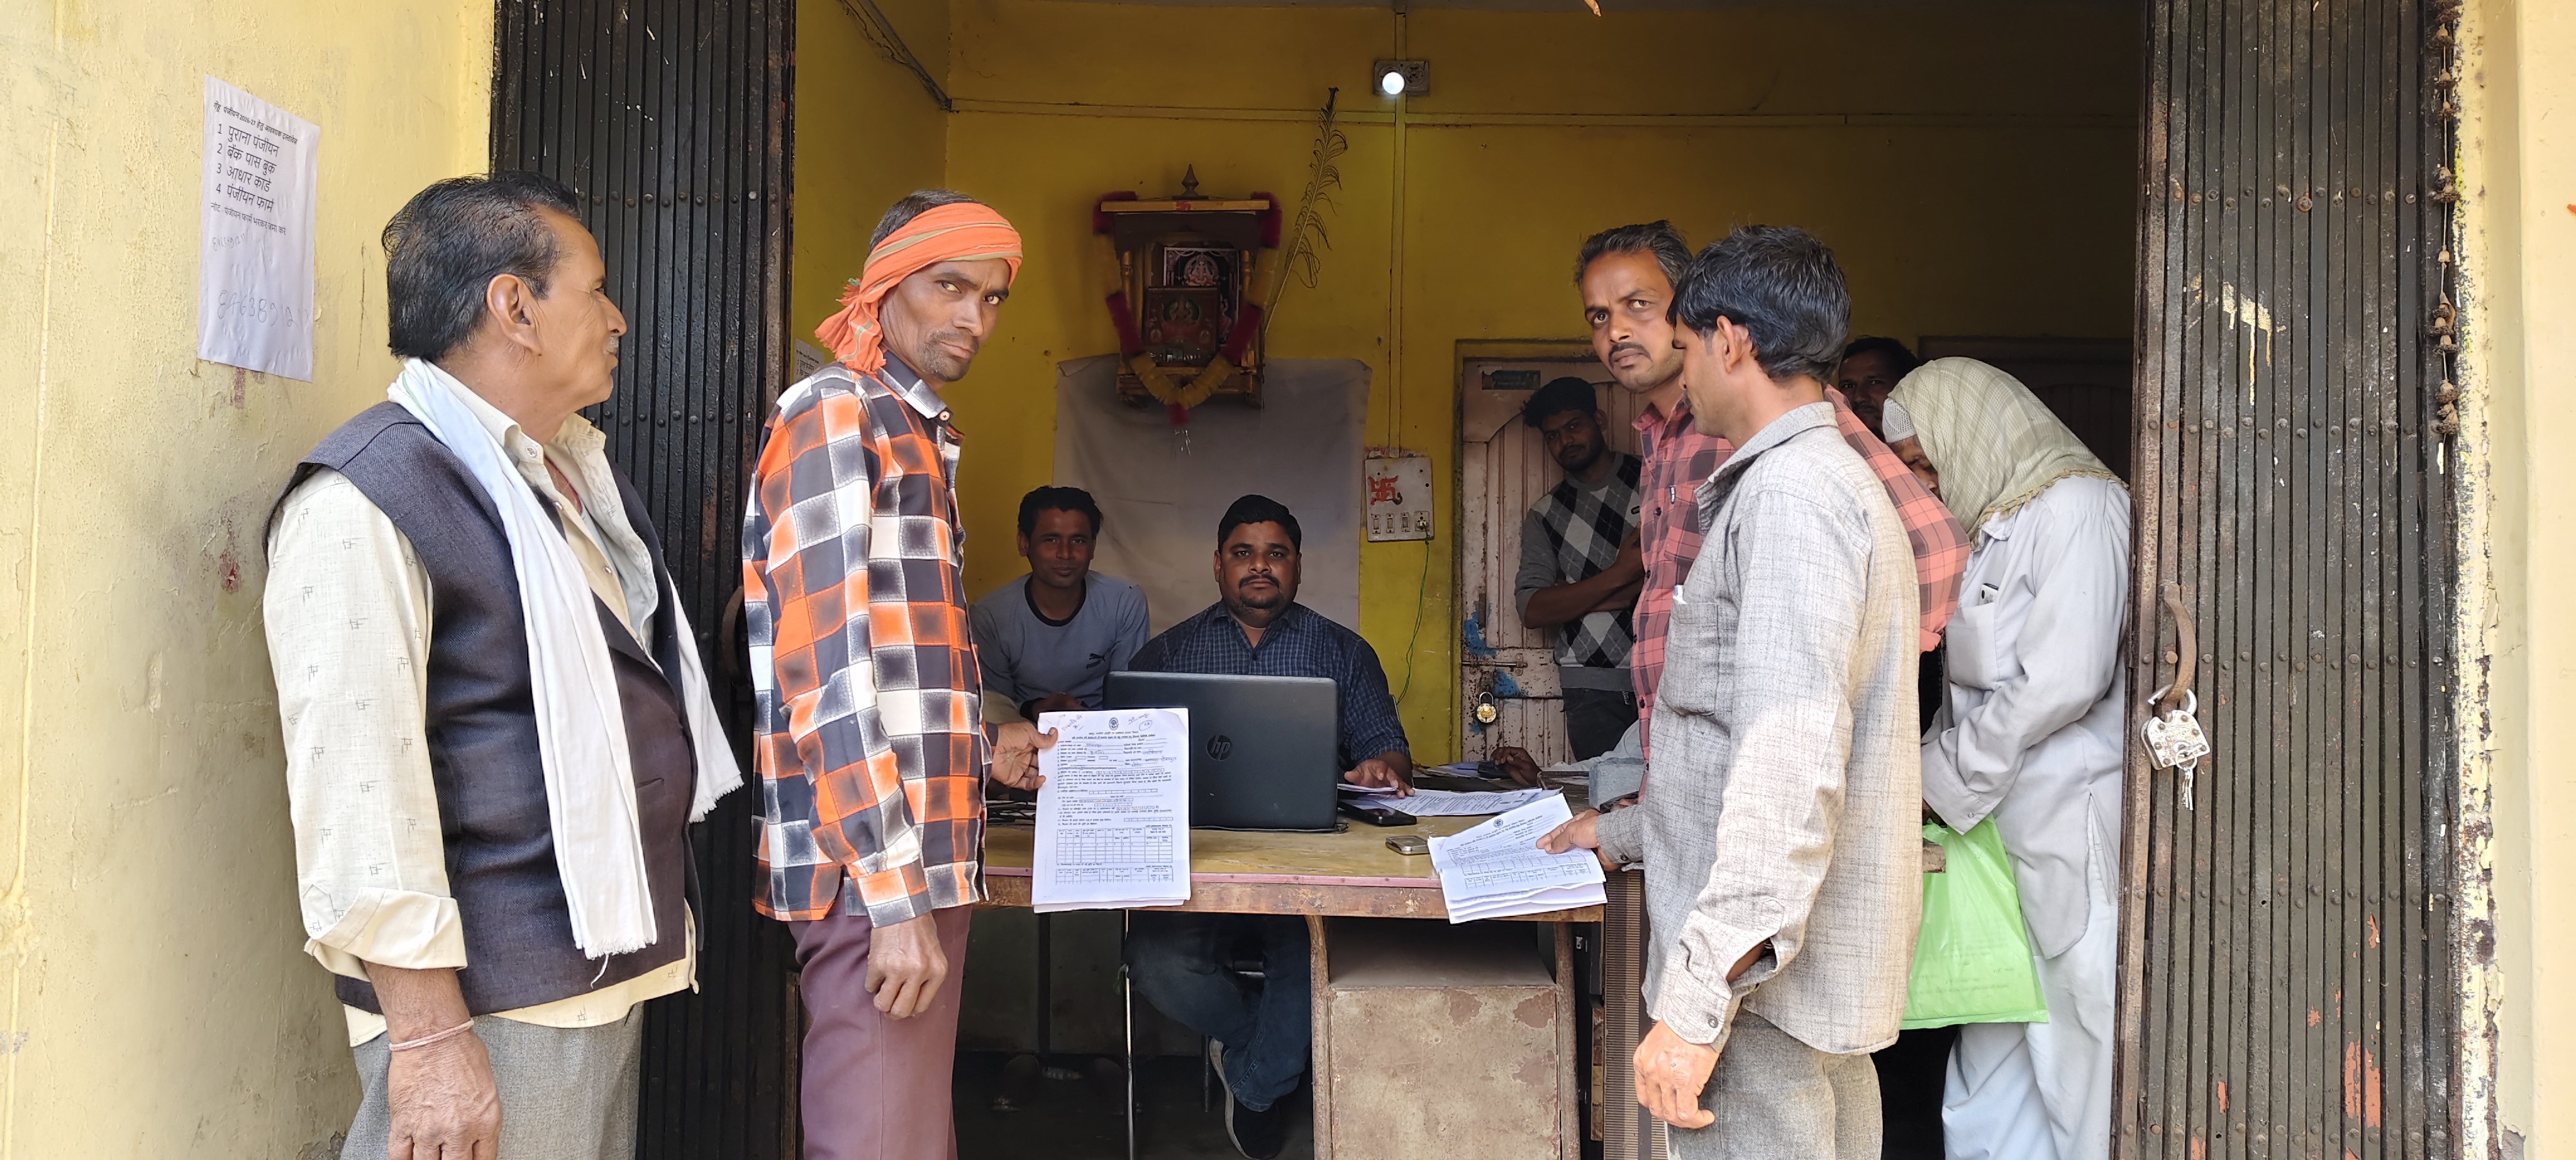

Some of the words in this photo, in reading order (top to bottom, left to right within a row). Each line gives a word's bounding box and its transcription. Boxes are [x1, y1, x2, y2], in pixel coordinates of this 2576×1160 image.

[224, 106, 240, 119] पंजीयन
[265, 125, 282, 137] आवश्यक
[218, 123, 222, 134] 1
[228, 126, 252, 145] पुराना
[253, 135, 279, 157] पंजीयन
[217, 143, 223, 154] 2
[245, 152, 262, 169] पास
[263, 160, 277, 176] बुक
[216, 163, 221, 174] 3
[226, 166, 253, 186] आधार
[254, 176, 272, 192] कार्ड
[216, 183, 221, 194] 4
[227, 184, 255, 206] पंजीयन
[257, 196, 274, 213] फार्म
[225, 206, 241, 220] पंजीयन
[253, 218, 267, 229] भरकर
[268, 222, 277, 232] जमा
[1210, 735, 1231, 761] hp
